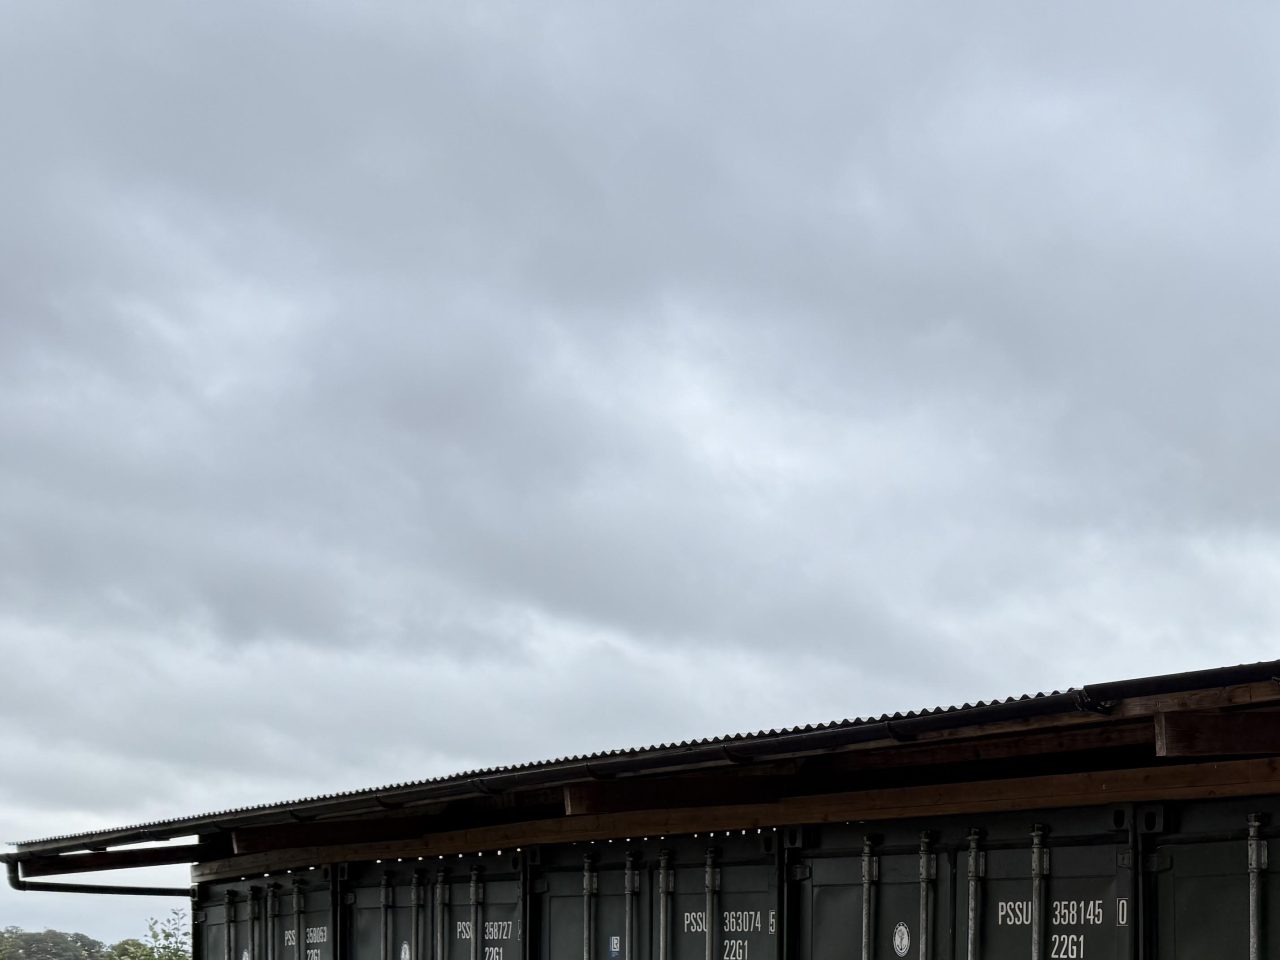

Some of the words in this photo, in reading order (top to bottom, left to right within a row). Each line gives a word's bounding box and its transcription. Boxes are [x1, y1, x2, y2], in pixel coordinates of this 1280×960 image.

[724, 911, 761, 931] 363074
[770, 911, 775, 932] 5
[998, 902, 1031, 925] PSSU
[1053, 900, 1102, 924] 358145
[285, 930, 295, 947] PSS
[457, 922, 471, 939] PSS
[485, 922, 512, 939] 358727
[724, 940, 747, 960] 22G1
[1051, 935, 1084, 958] 22G1
